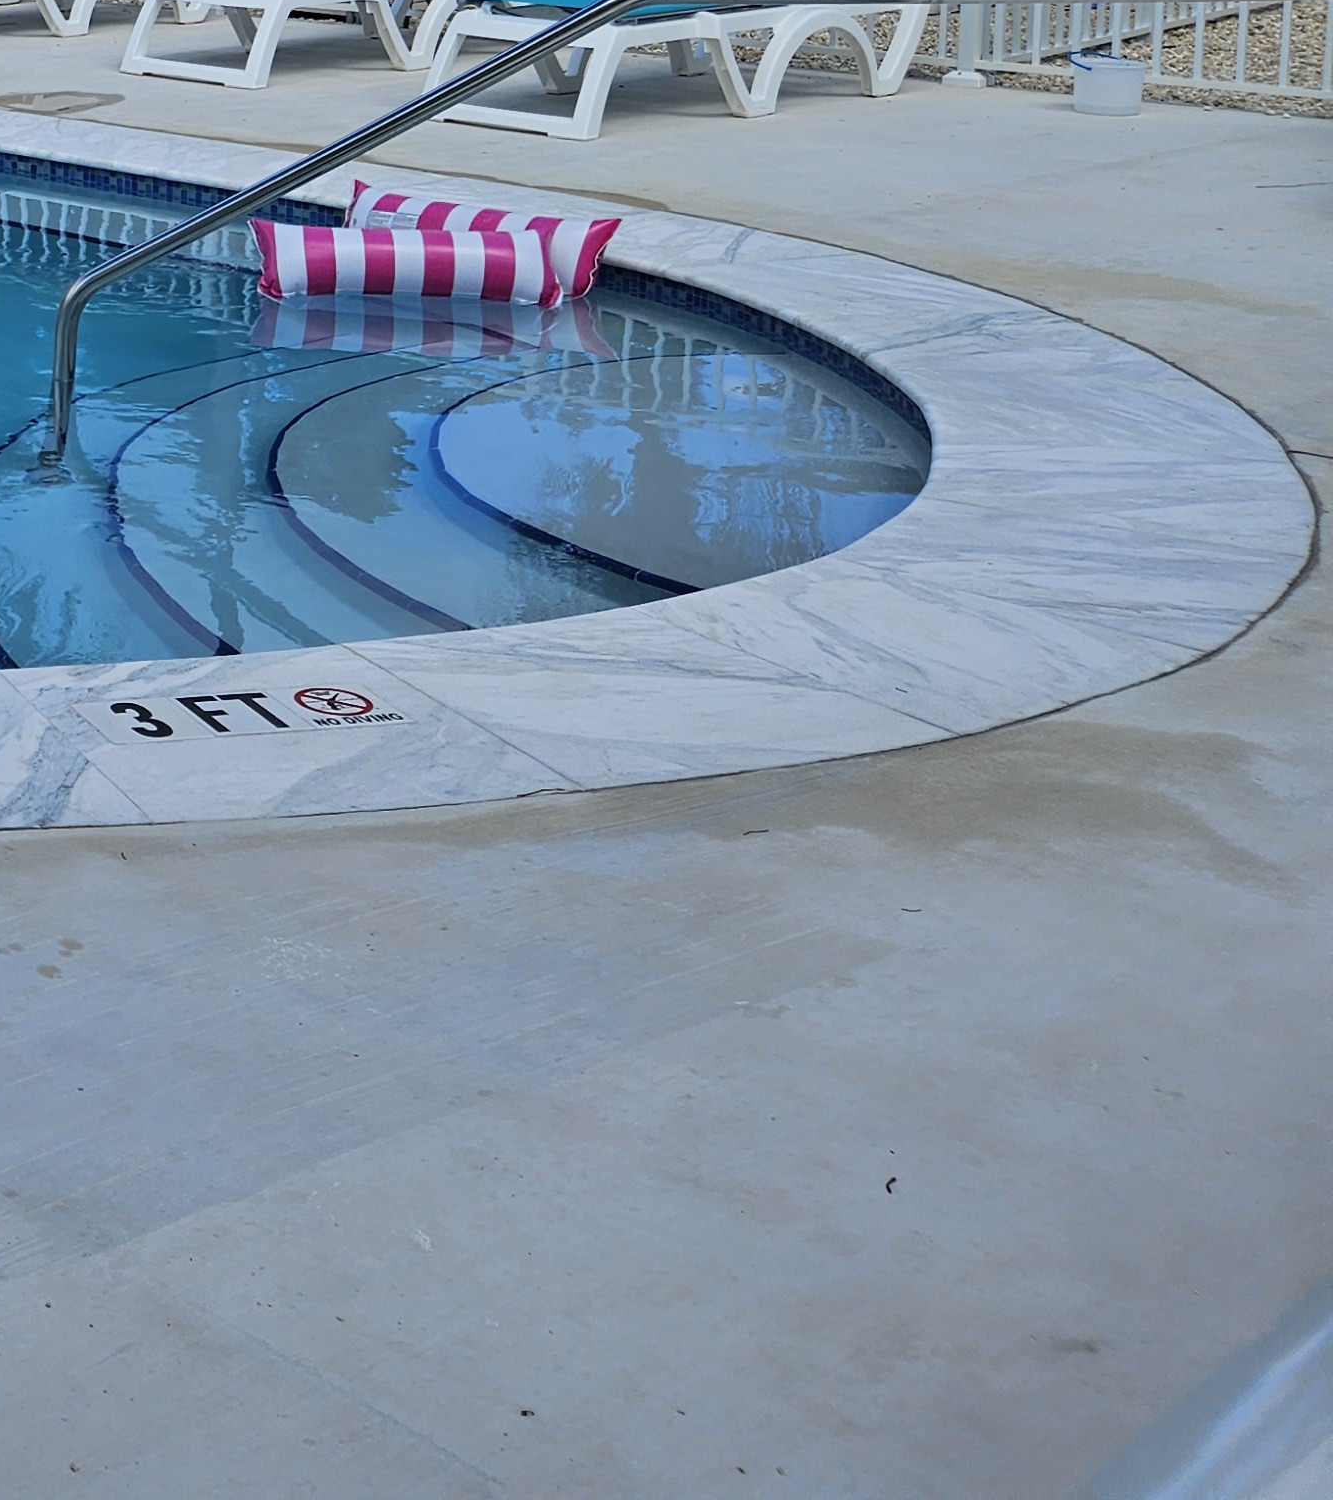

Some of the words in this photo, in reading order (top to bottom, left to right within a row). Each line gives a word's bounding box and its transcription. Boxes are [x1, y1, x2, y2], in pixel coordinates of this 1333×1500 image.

[109, 702, 174, 738] 3
[175, 692, 290, 733] FT
[313, 716, 343, 727] NO
[344, 711, 405, 725] DIVING
